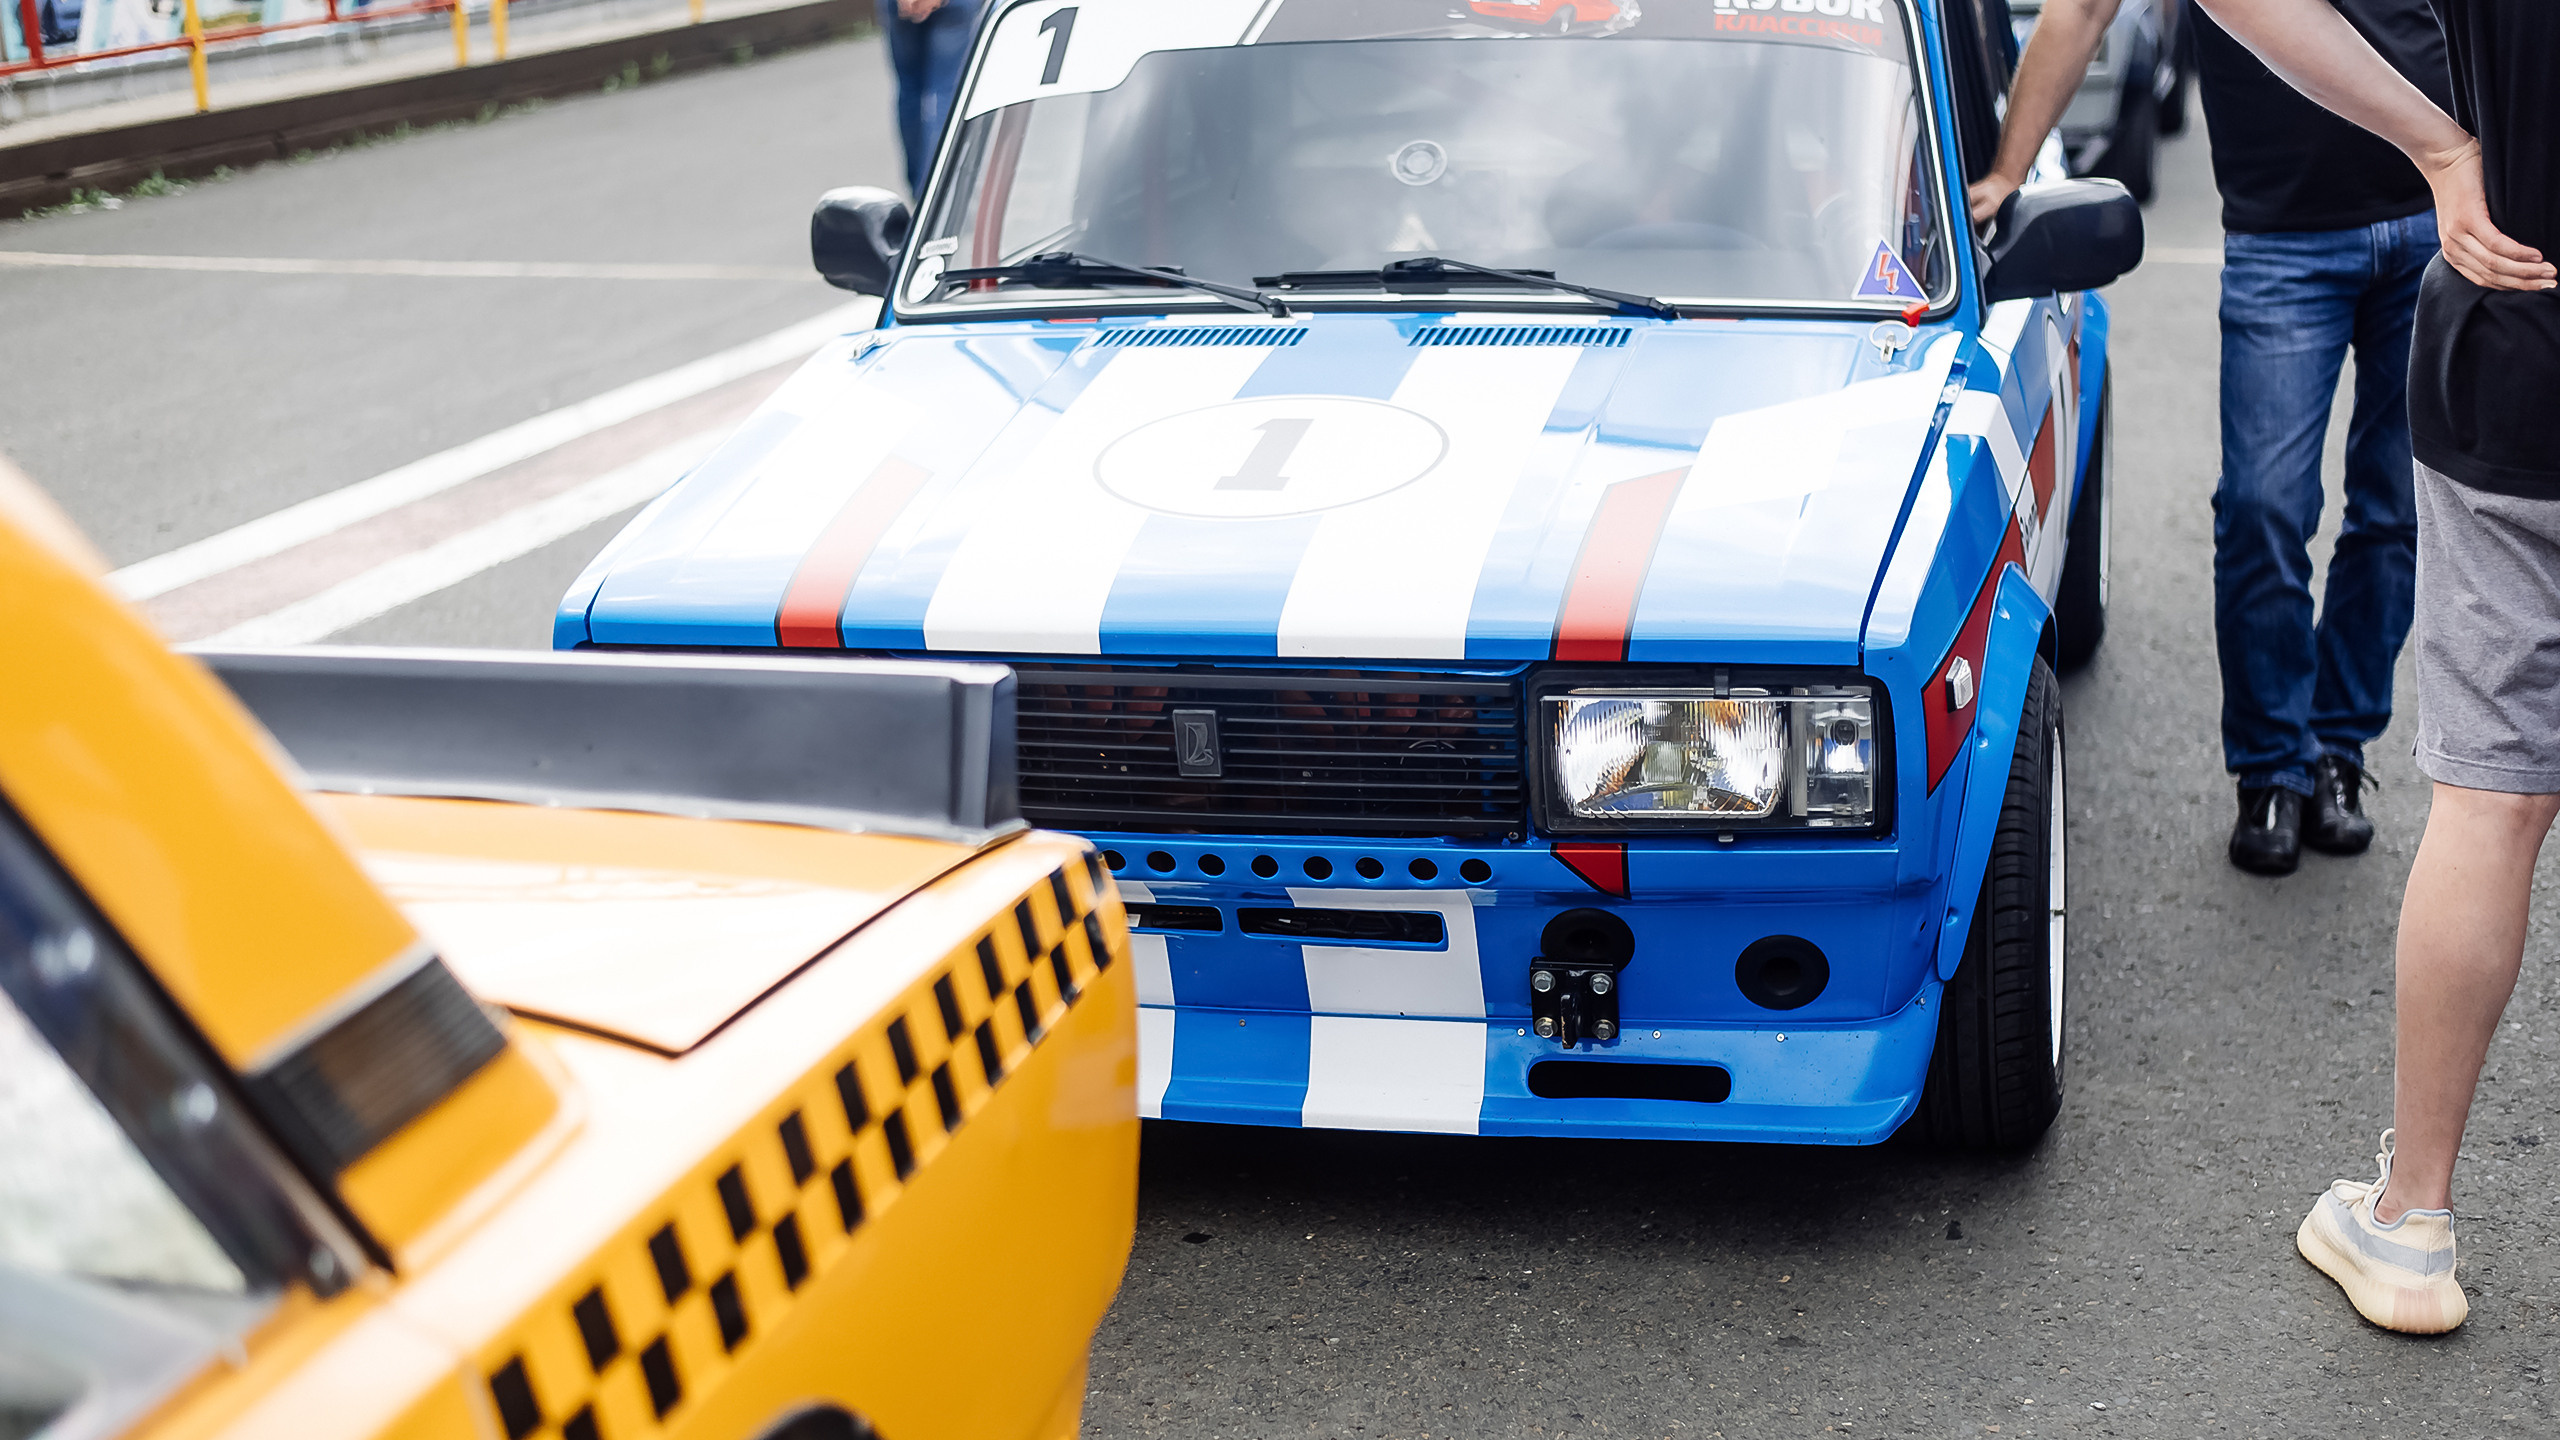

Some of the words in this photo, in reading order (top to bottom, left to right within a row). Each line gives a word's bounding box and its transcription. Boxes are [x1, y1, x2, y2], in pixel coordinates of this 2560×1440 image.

[1038, 7, 1079, 85] 1
[1714, 14, 1883, 46] КЛАССИКИ
[1213, 418, 1315, 491] 1
